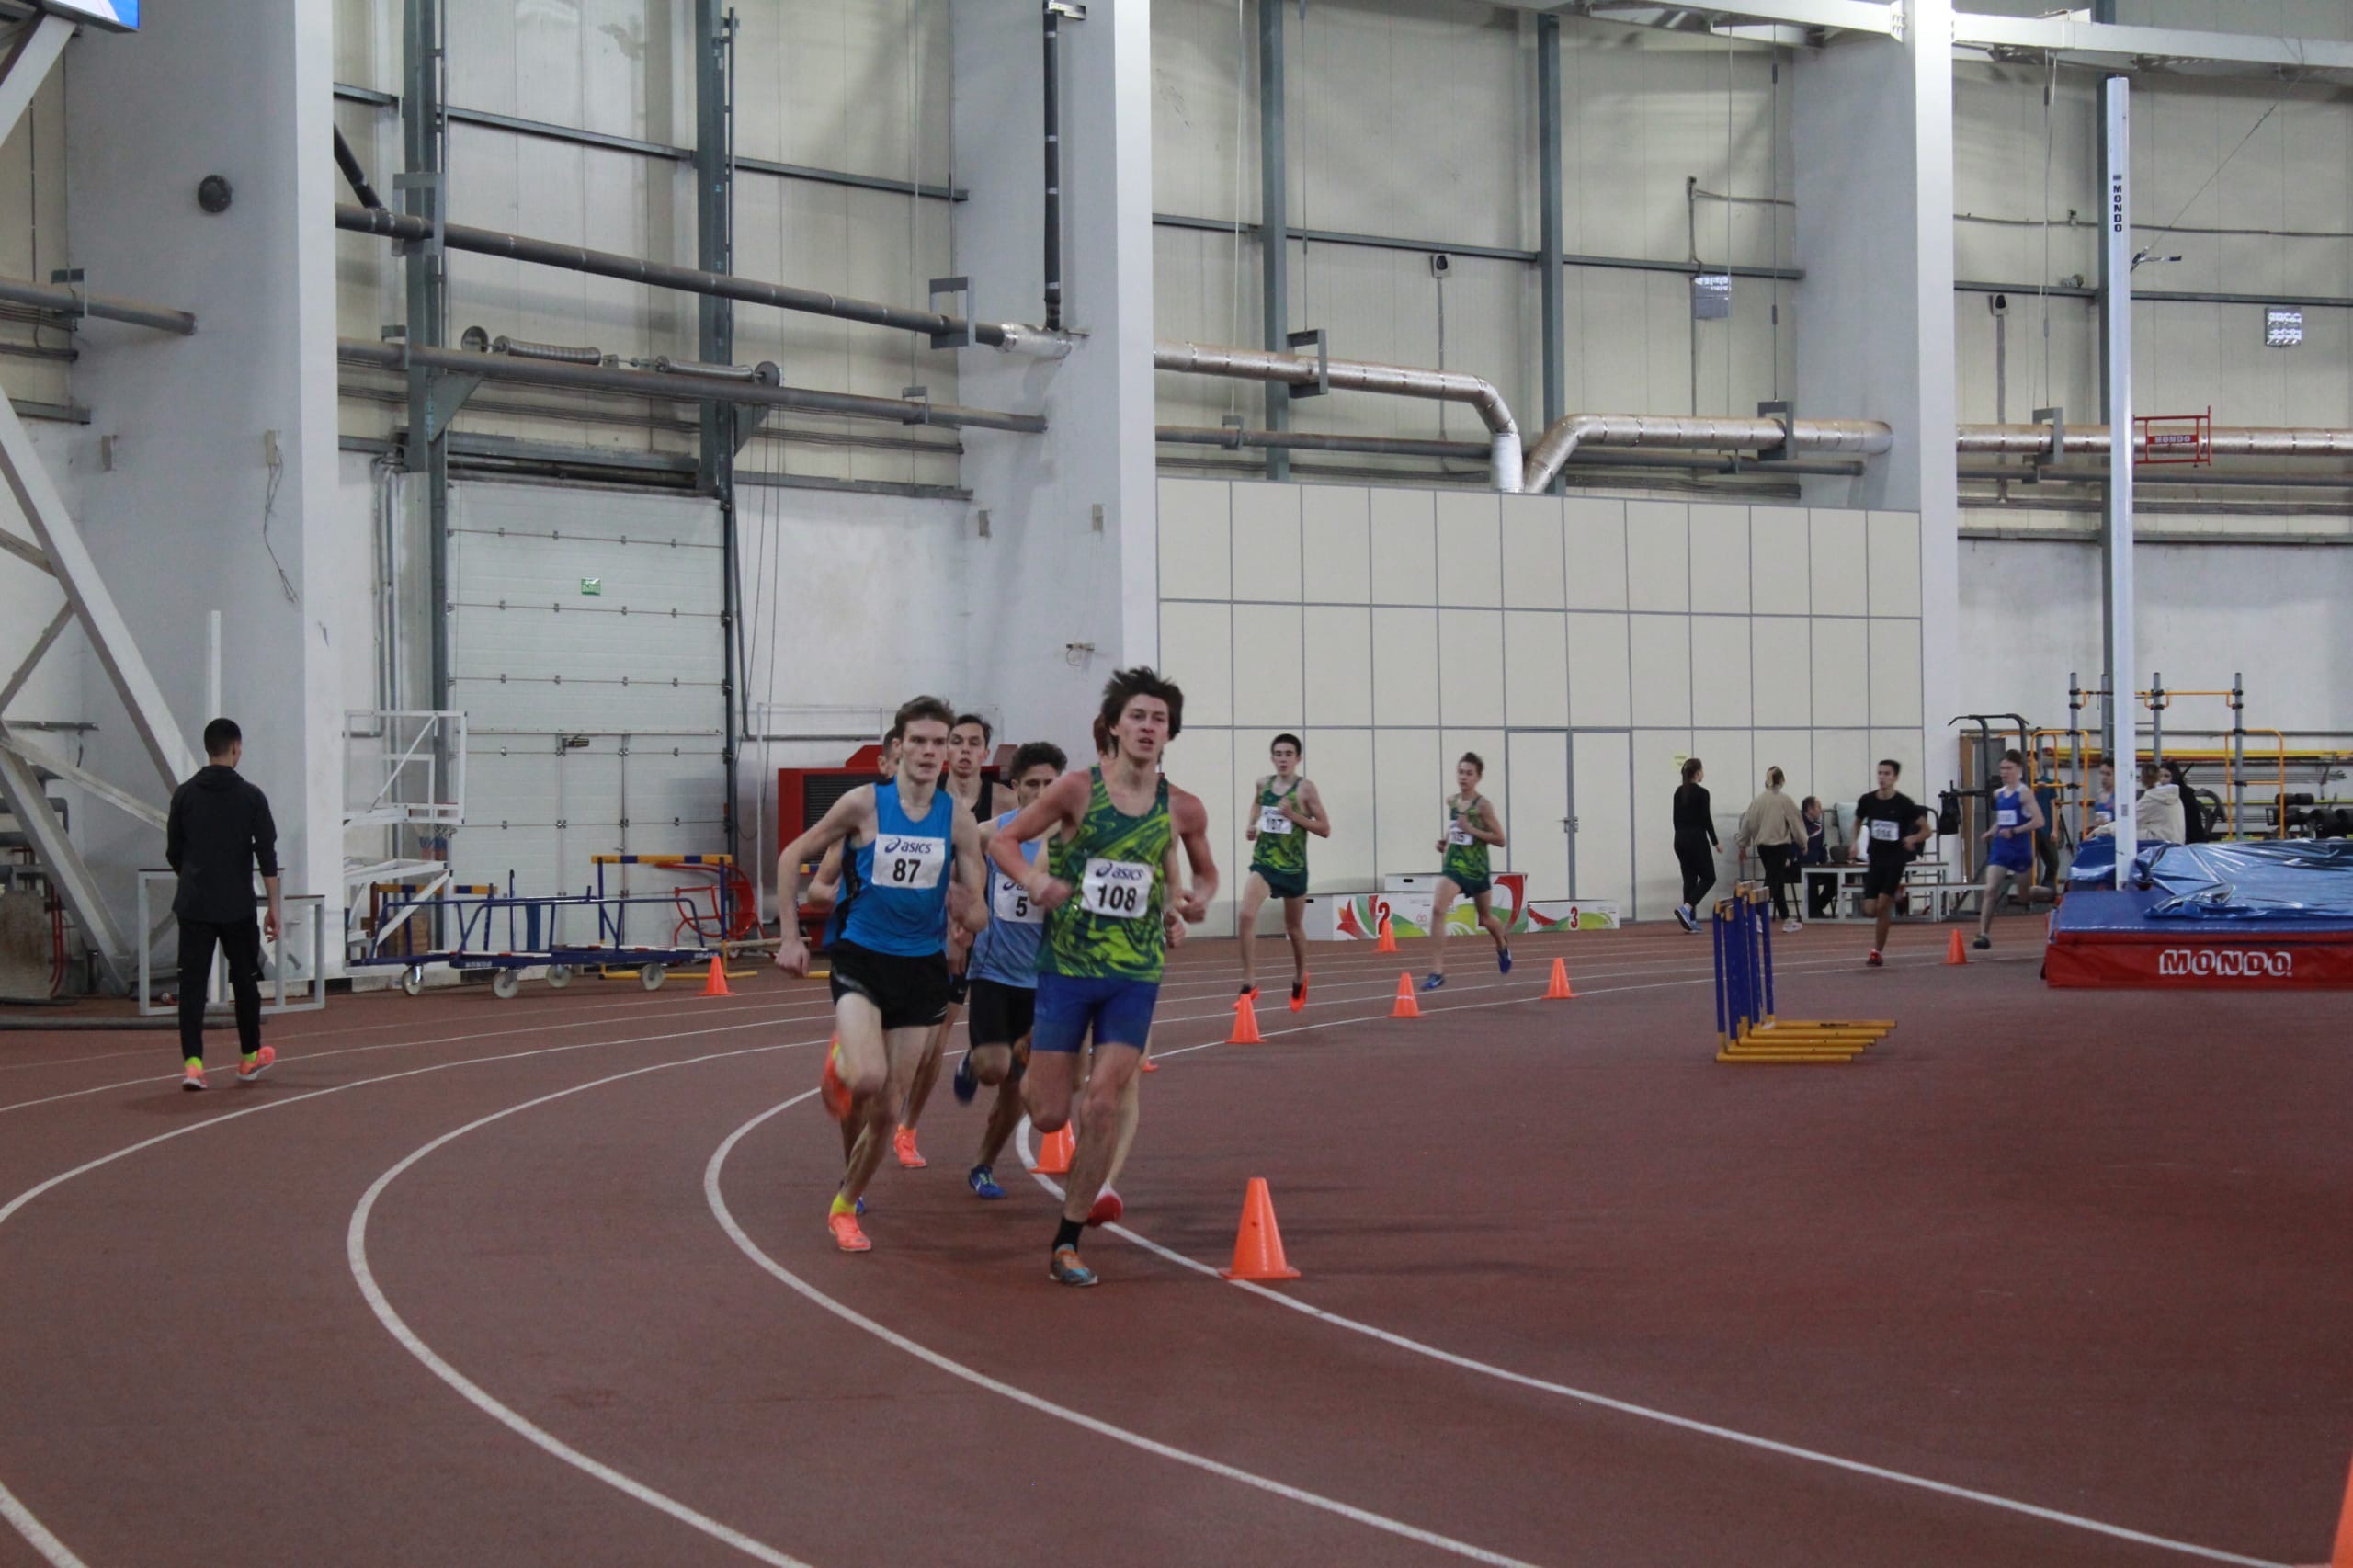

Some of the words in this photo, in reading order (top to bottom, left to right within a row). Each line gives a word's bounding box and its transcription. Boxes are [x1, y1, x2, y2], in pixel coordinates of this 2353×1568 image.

[2113, 185, 2122, 232] MONDO
[901, 842, 932, 854] asics
[893, 858, 921, 883] 87
[1016, 896, 1028, 917] 5
[1098, 884, 1137, 912] 108
[1570, 905, 1578, 928] 3
[2159, 949, 2292, 976] MONDO
